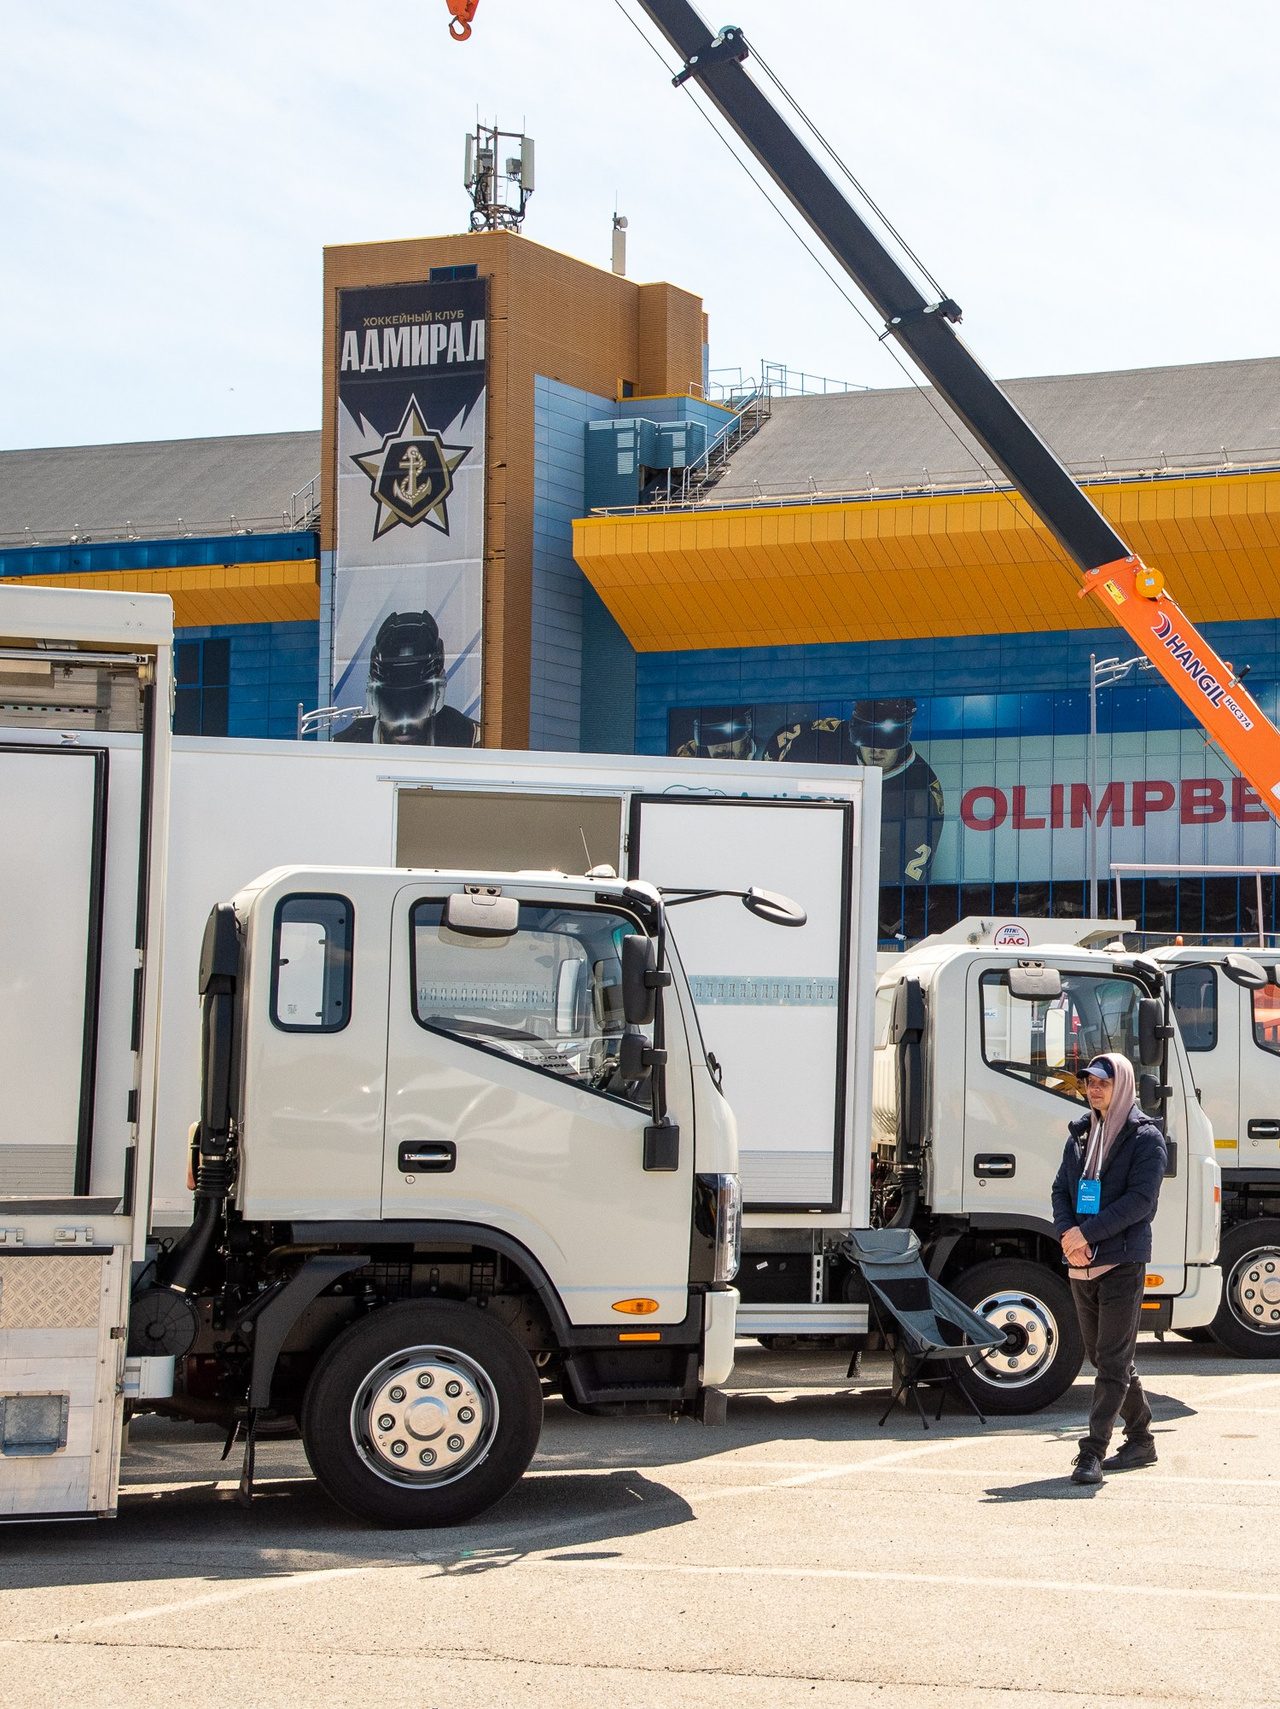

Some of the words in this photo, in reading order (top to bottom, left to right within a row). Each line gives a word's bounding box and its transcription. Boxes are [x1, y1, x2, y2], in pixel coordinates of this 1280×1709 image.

[363, 311, 432, 326] ХОККЕЙНЫЙ
[435, 309, 465, 321] КЛУБ
[340, 319, 486, 373] АДМИРАЛ
[1164, 633, 1224, 709] HANGIL
[1224, 697, 1252, 728] HGC374
[960, 777, 1270, 831] OLIMPBE
[998, 937, 1026, 946] JAC
